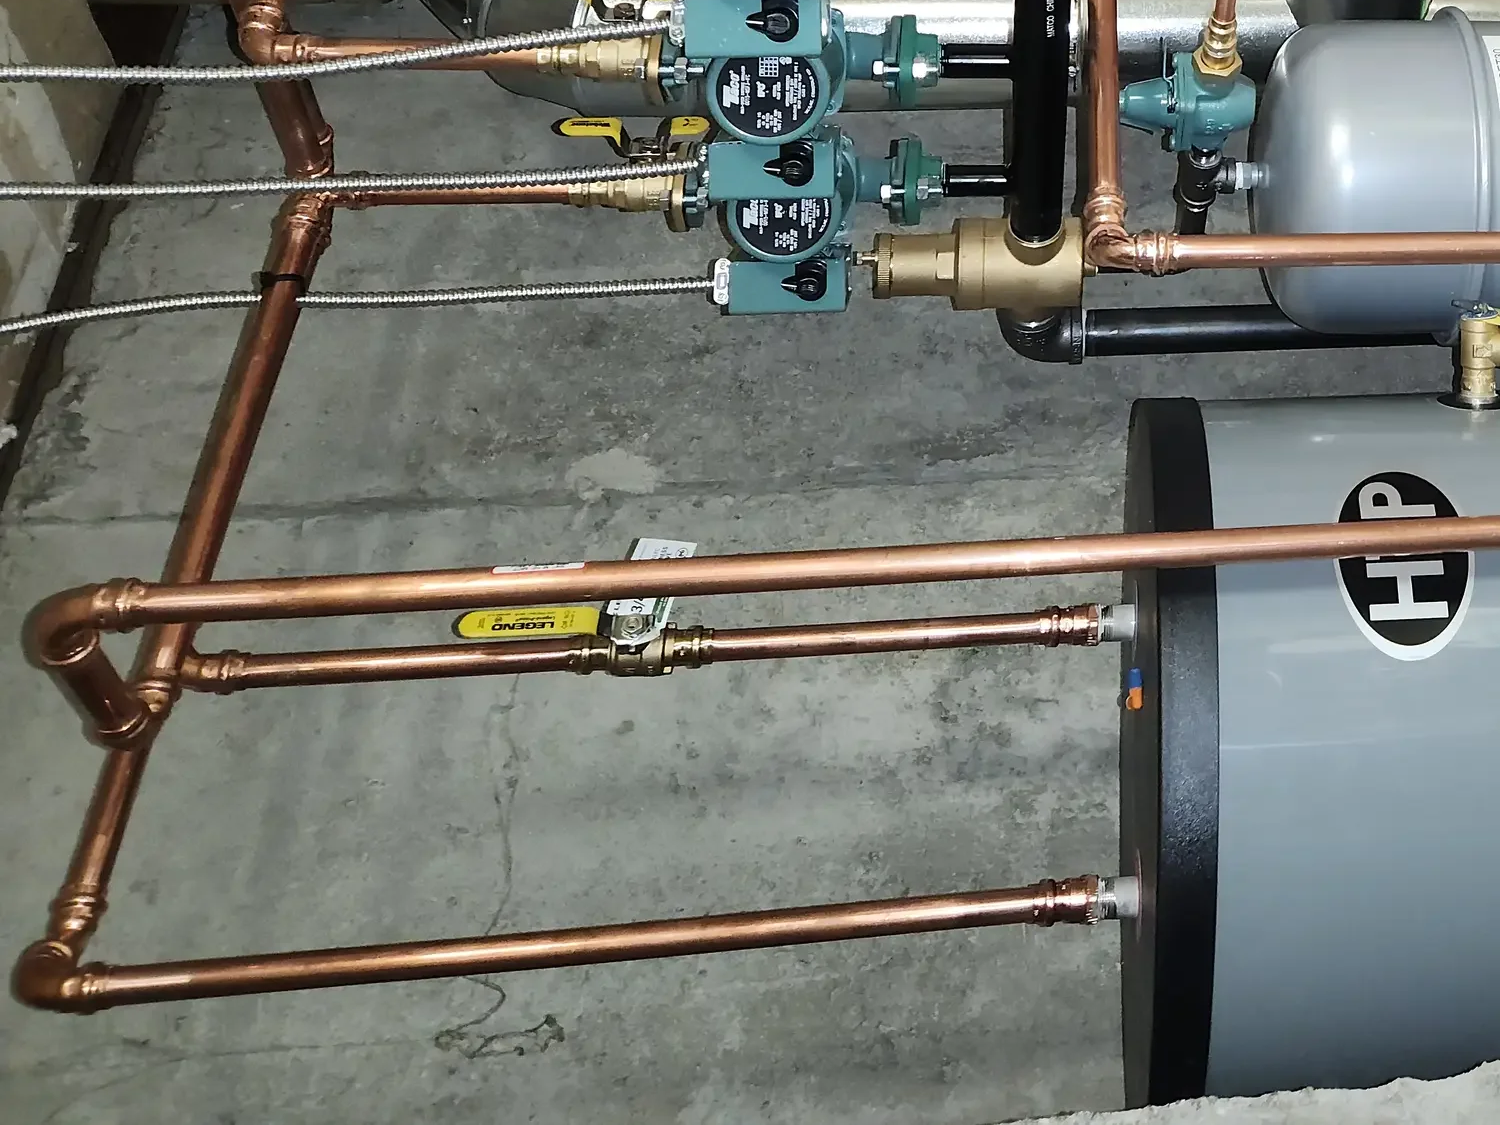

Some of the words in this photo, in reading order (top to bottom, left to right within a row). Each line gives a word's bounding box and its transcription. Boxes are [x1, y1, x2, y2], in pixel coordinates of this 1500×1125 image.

[1359, 482, 1449, 621] HP
[631, 598, 645, 613] 3/
[491, 621, 555, 631] LEGEND
